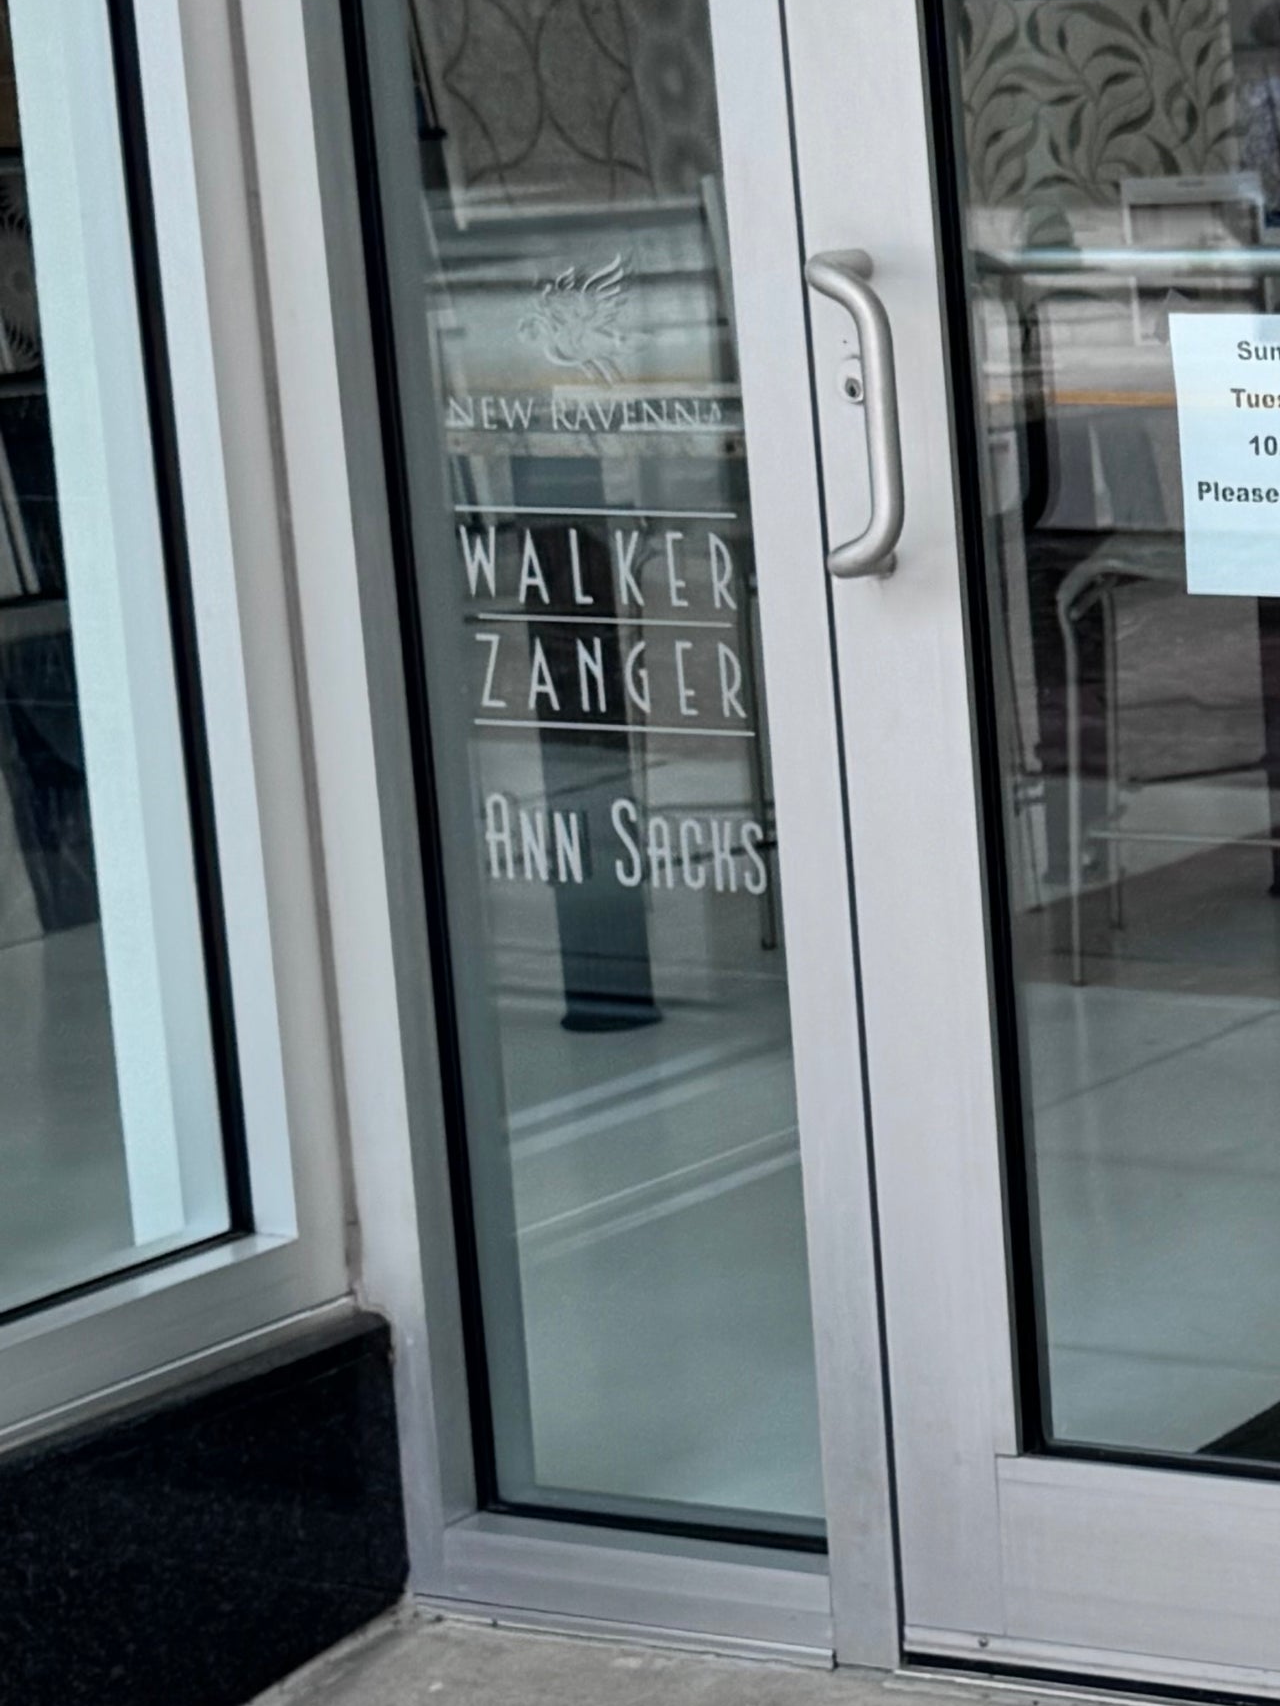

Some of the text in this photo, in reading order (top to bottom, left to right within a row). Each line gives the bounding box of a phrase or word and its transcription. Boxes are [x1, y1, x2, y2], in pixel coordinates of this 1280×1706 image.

[448, 396, 723, 431] NEW RAVENNA
[1198, 481, 1280, 503] Please
[458, 525, 739, 611] WALKER
[474, 633, 747, 718] ZANGER
[484, 793, 768, 895] ANN SACKS
